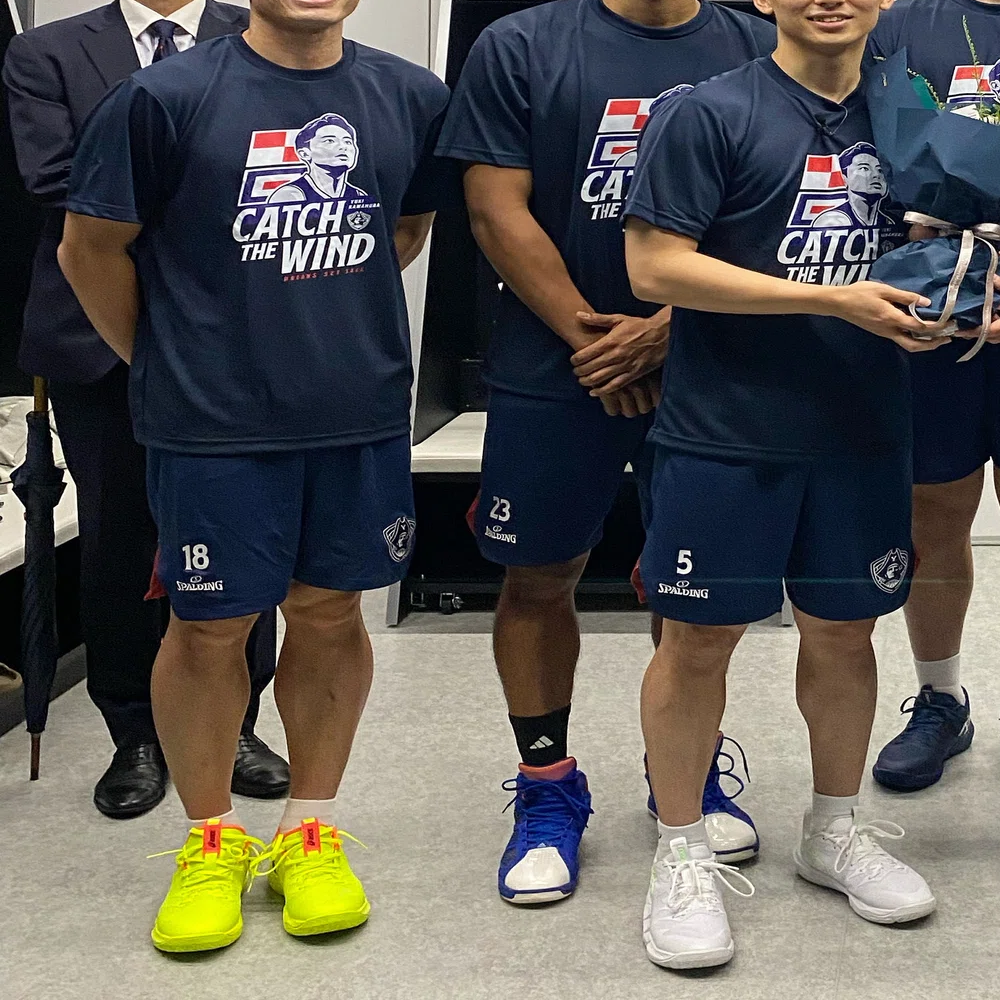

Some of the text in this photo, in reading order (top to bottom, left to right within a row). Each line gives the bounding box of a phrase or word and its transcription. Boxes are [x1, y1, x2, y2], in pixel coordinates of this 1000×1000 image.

[232, 200, 346, 242] CATCH
[591, 202, 622, 220] THE
[241, 232, 376, 275] THE WIND
[776, 229, 880, 265] CATCH
[786, 265, 820, 283] THE
[489, 496, 511, 522] 23
[182, 543, 210, 571] 18
[676, 549, 693, 575] 5
[176, 580, 224, 592] SPALDING
[657, 582, 709, 599] SPALDING
